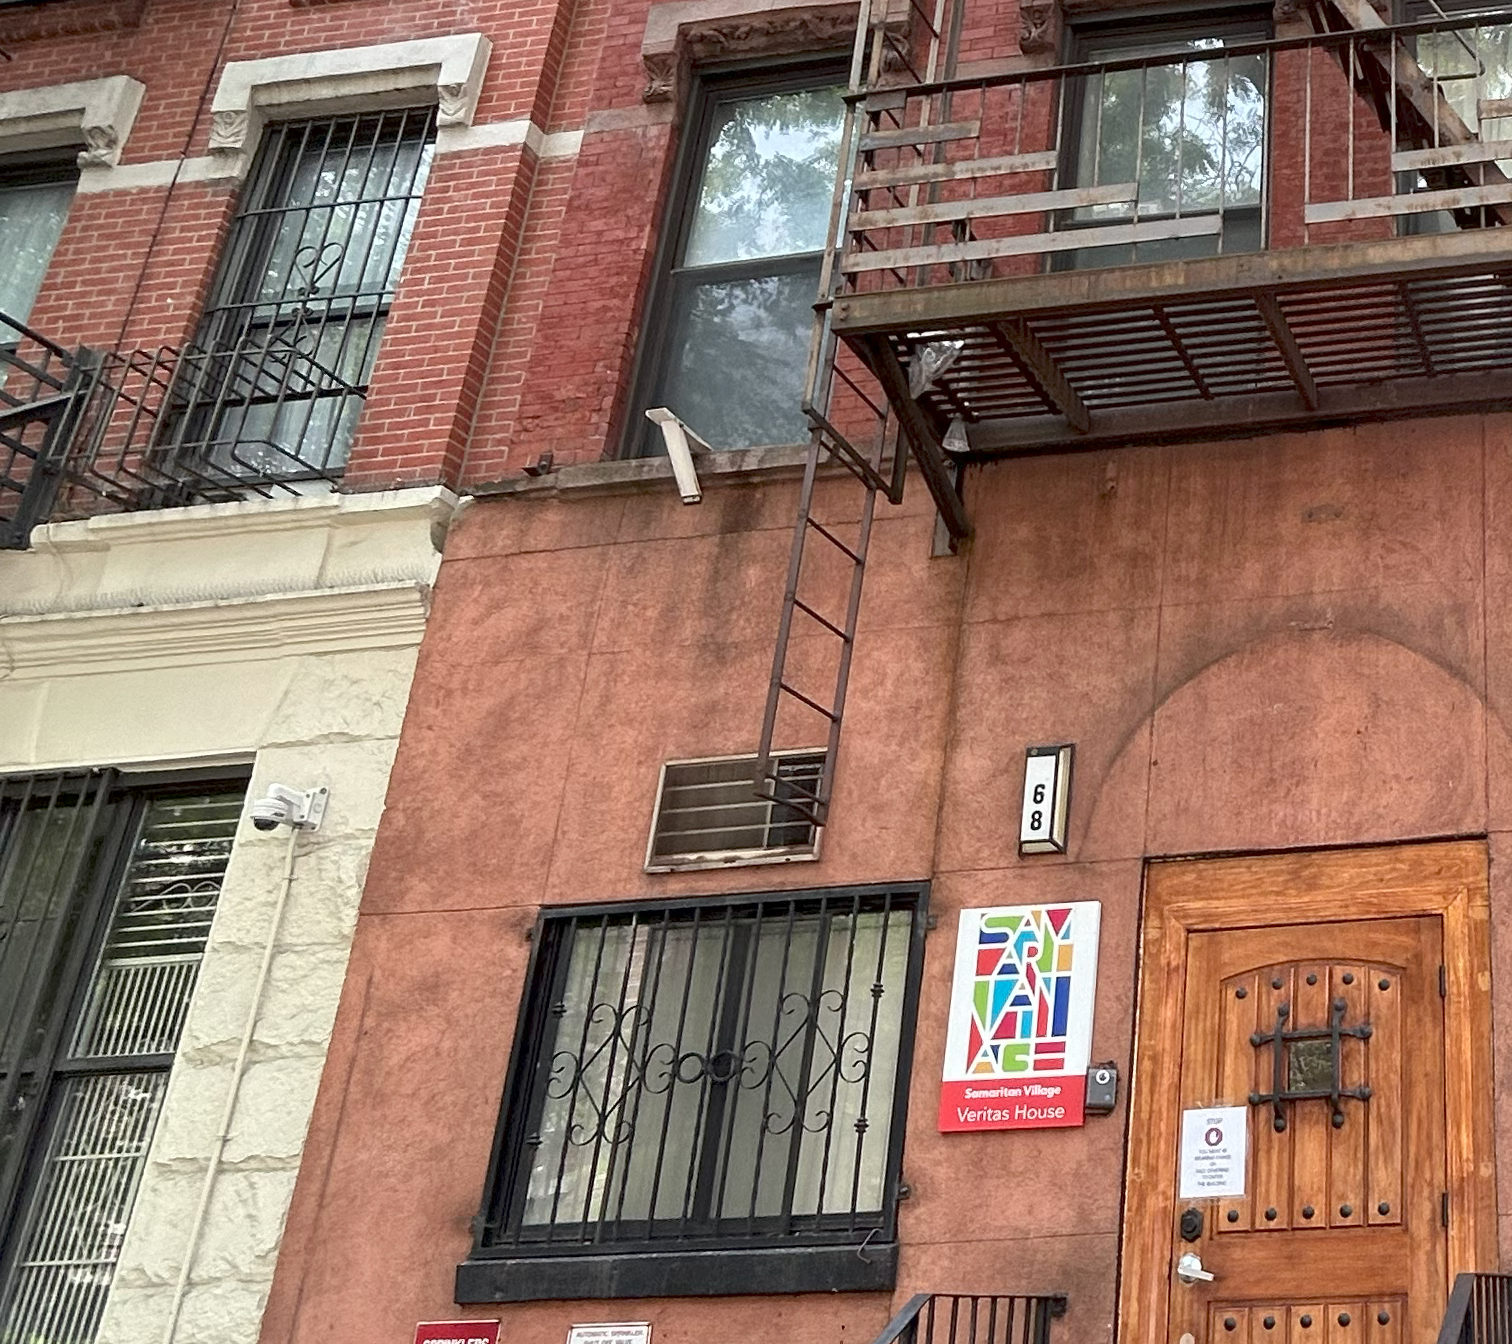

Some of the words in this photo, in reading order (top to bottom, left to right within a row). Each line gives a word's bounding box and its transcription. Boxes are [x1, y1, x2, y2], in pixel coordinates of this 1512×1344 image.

[1030, 783, 1046, 831] 68
[964, 1086, 1022, 1099] Samaritan
[1023, 1084, 1062, 1097] Village
[956, 1106, 1010, 1123] Veritas
[1014, 1104, 1066, 1120] House
